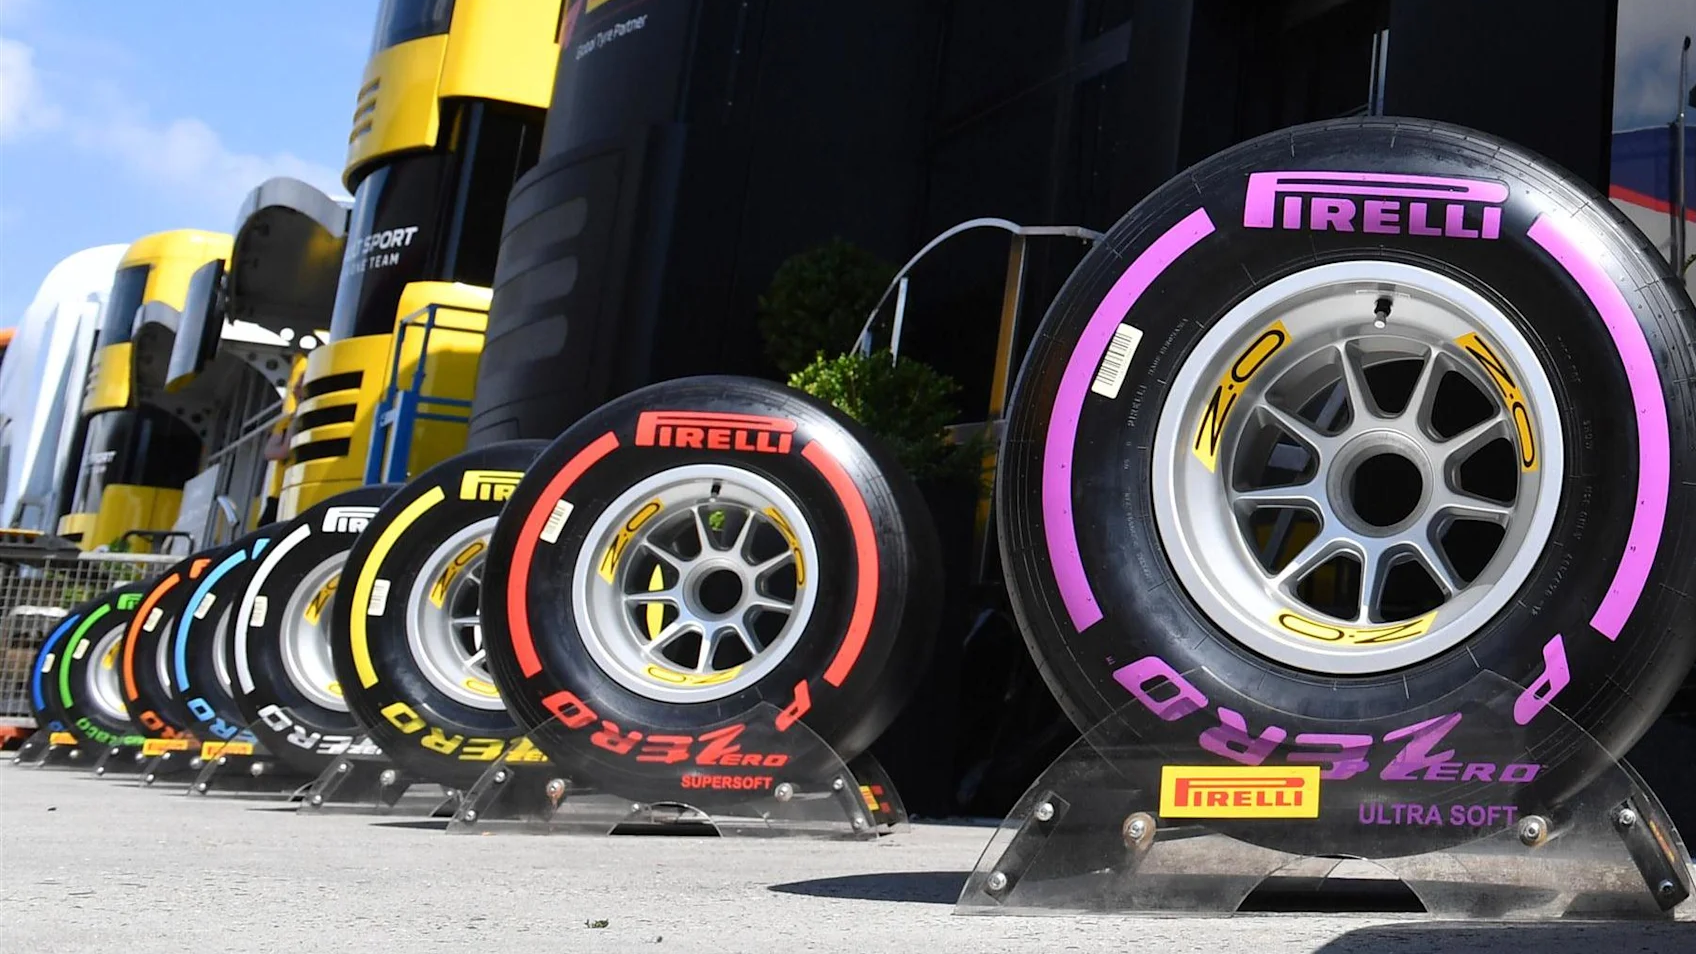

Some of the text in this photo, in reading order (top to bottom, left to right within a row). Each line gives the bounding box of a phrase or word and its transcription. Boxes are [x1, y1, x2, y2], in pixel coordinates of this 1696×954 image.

[1243, 171, 1509, 240] PIRELLI
[362, 226, 419, 255] SPORT
[369, 251, 400, 269] TEAM
[635, 410, 798, 454] PIRELLI
[541, 690, 746, 765] ZERO
[1112, 655, 1463, 782] ZERO
[680, 774, 774, 790] SUPERSOFT
[1379, 762, 1542, 783] ZERO
[1174, 777, 1306, 807] PIRELLI
[1358, 803, 1518, 826] ULTRA SOFT
